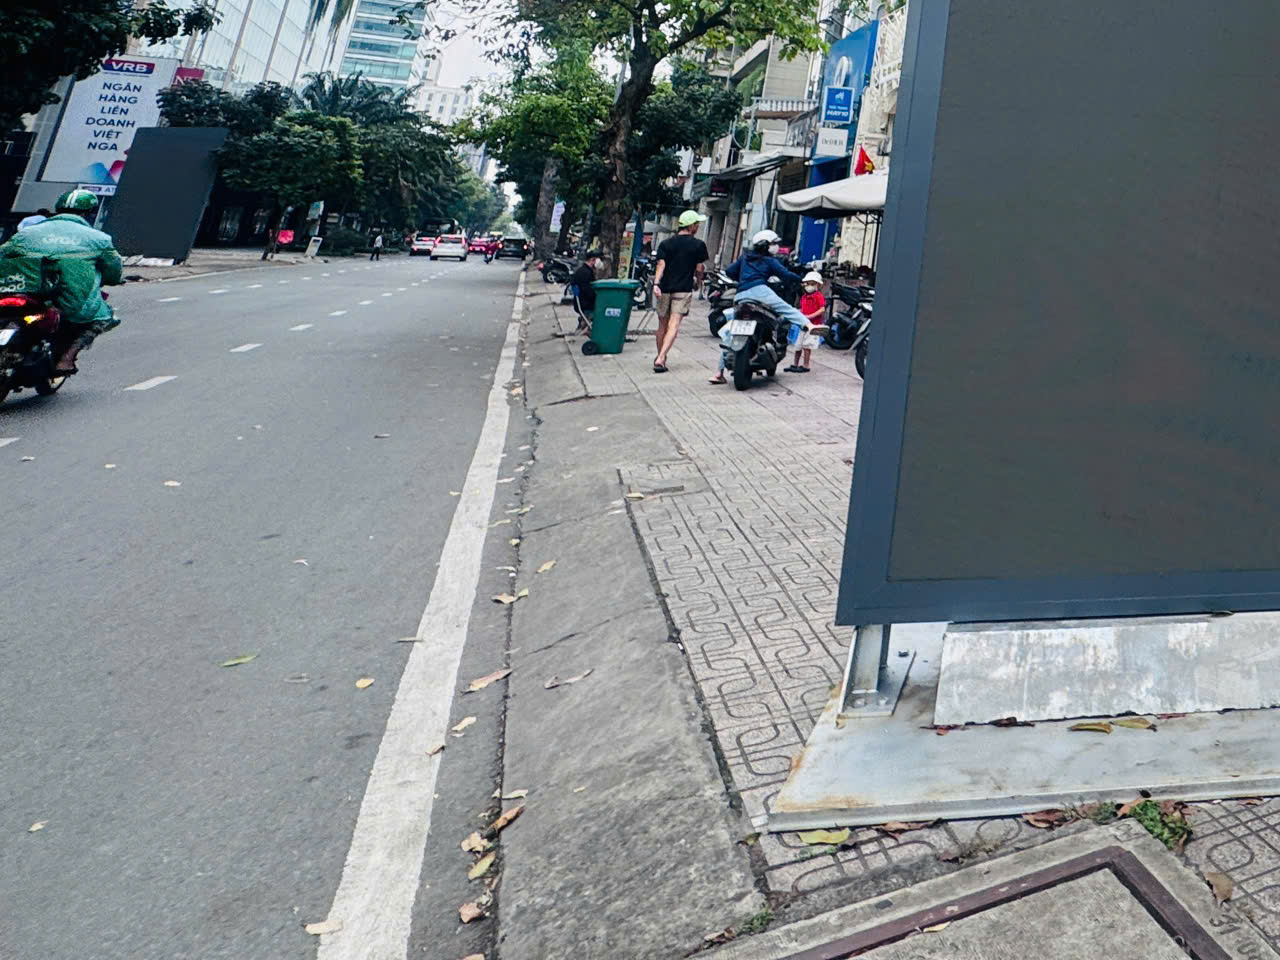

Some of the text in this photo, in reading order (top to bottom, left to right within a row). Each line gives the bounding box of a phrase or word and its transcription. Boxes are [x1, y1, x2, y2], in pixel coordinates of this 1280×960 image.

[111, 61, 148, 73] VRB
[102, 81, 143, 93] NGÂN
[98, 93, 138, 104] HÀNG
[100, 105, 129, 115] LIÊN
[85, 117, 136, 128] DOANH
[93, 128, 123, 140] VIỆT
[87, 141, 119, 151] NGA
